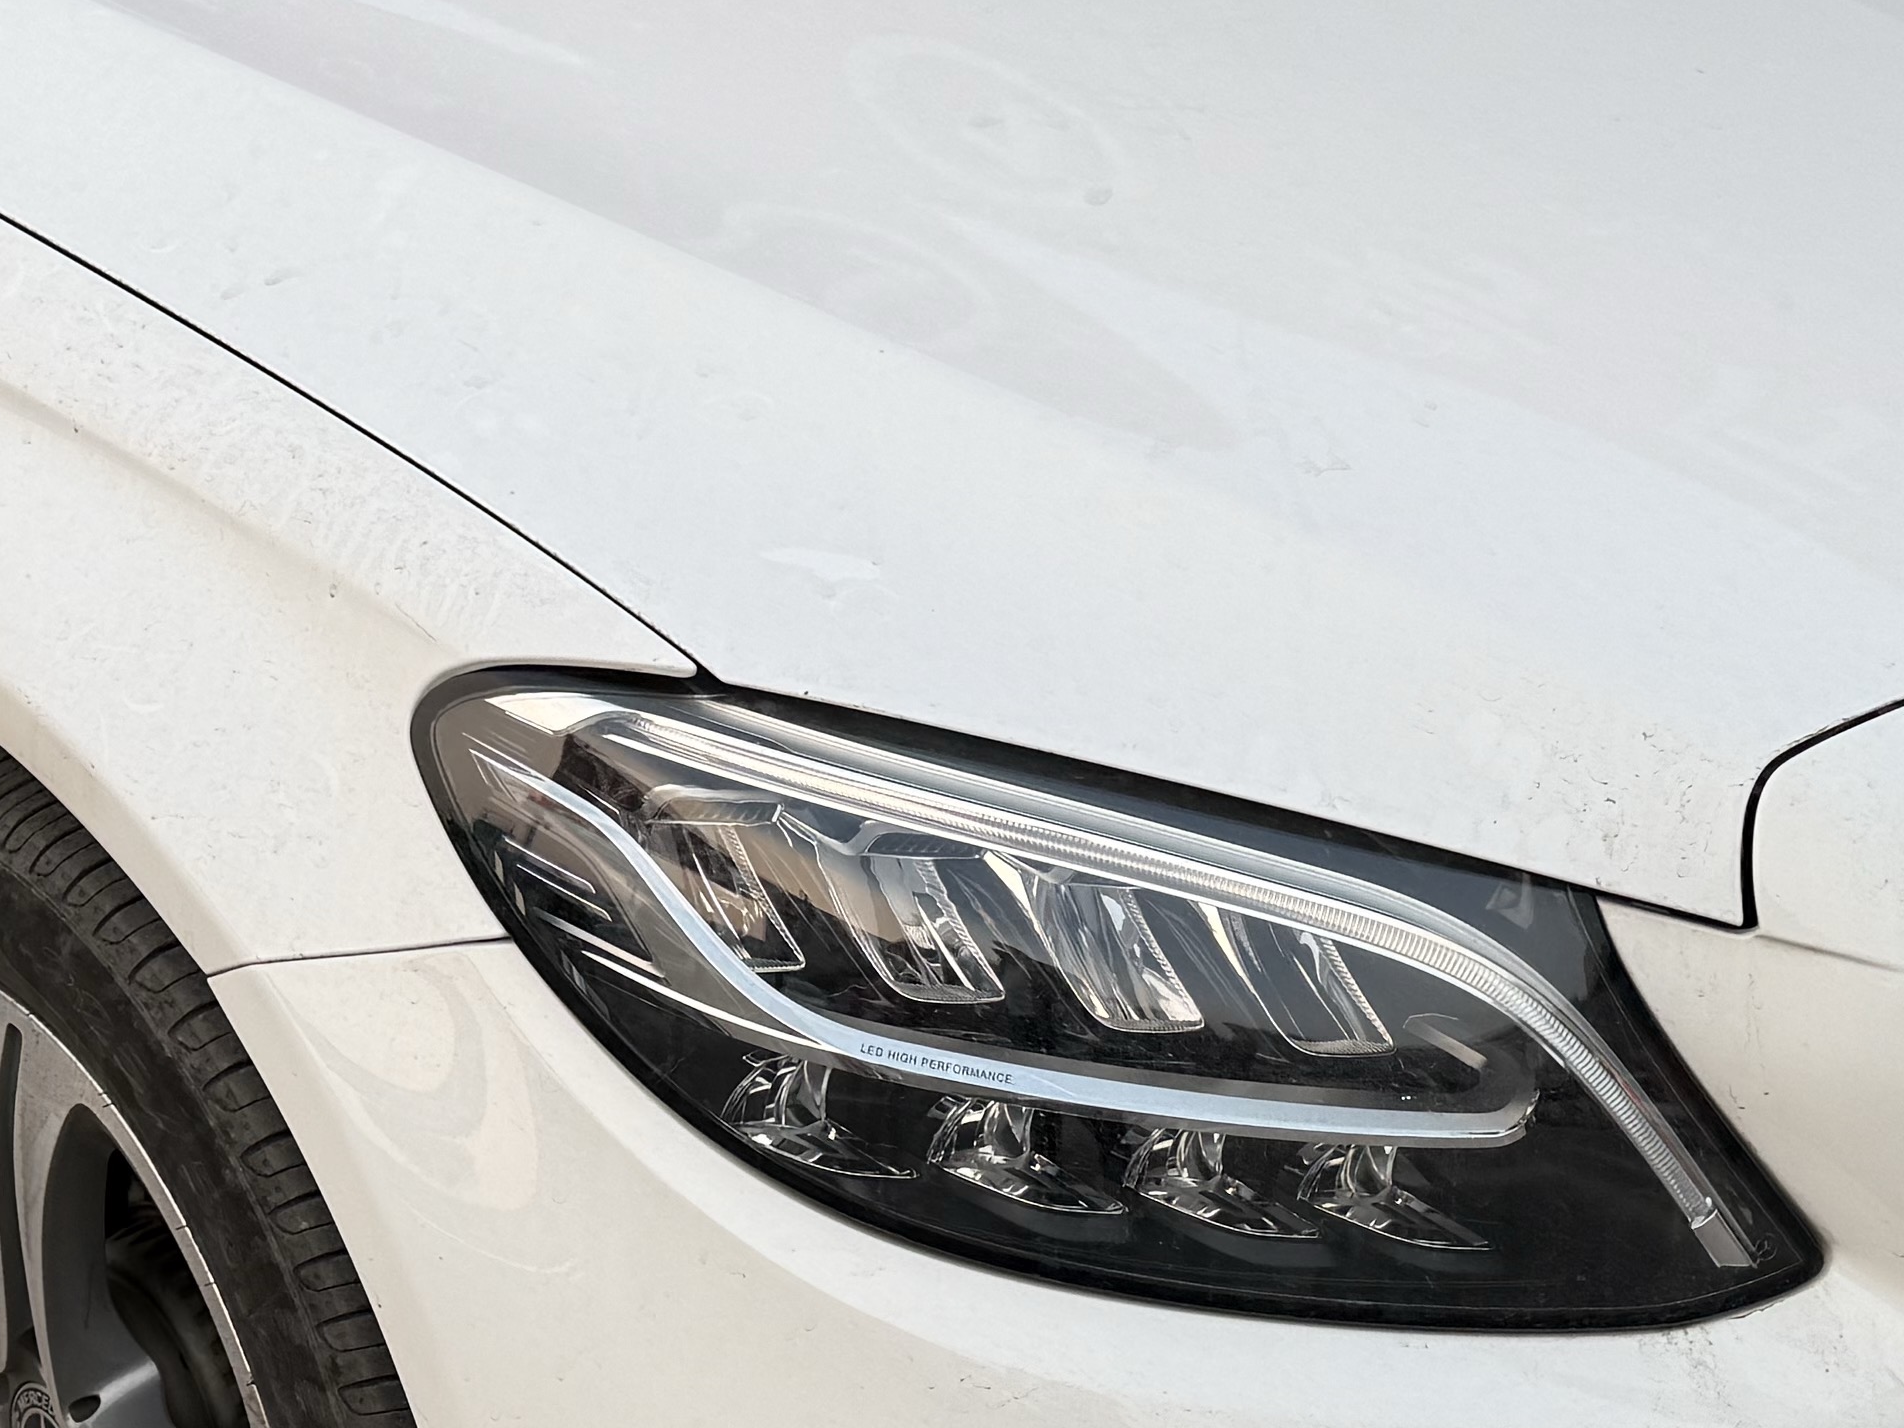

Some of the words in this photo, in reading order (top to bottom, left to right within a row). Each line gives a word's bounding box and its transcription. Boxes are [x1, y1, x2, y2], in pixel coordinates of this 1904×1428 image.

[860, 1042, 884, 1058] LED
[887, 1049, 918, 1066] HIGH
[920, 1056, 1014, 1085] PERFORMANCE
